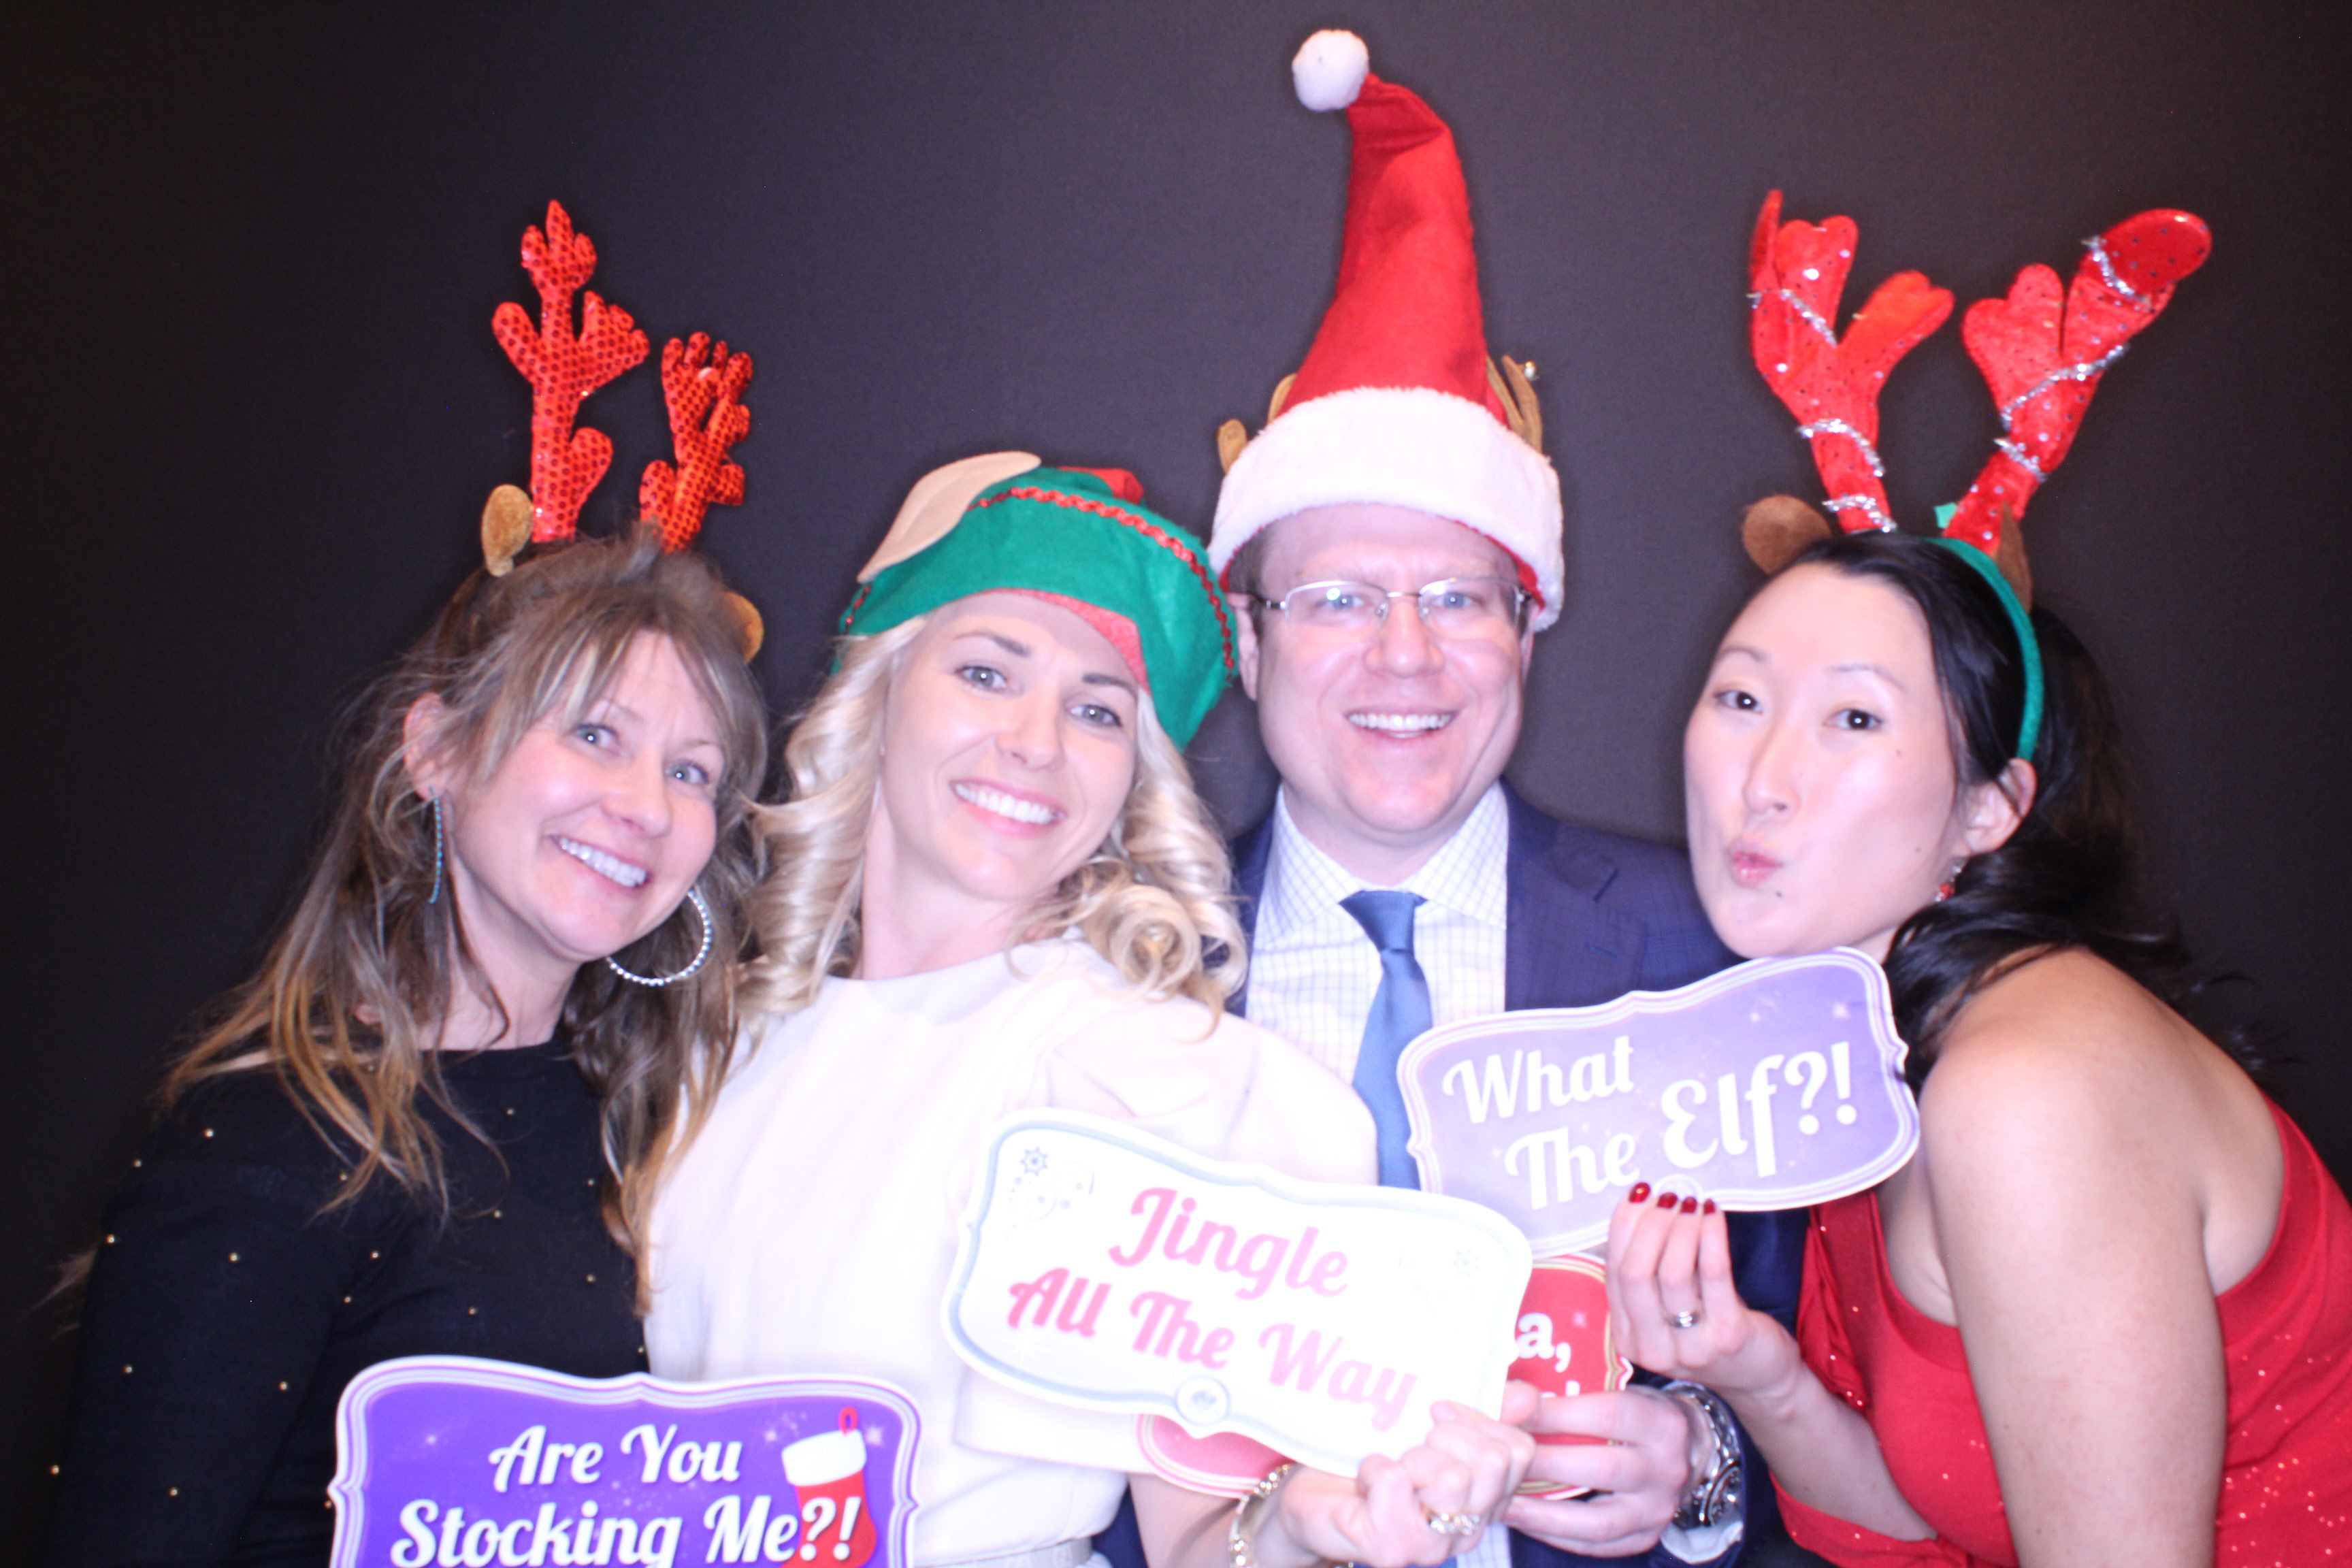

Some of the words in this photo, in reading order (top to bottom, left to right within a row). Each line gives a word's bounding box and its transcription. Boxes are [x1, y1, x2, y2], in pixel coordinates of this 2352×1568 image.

[1442, 1035, 1635, 1124] What
[1505, 1126, 1640, 1210] The
[1661, 1041, 1857, 1177] Elf?!
[1109, 1187, 1350, 1301] Jingle
[1007, 1267, 1111, 1338] All
[1130, 1290, 1236, 1370] The
[1258, 1322, 1418, 1432] Way
[488, 1424, 604, 1492] Are
[620, 1423, 742, 1484] You
[390, 1499, 683, 1568] Stocking
[703, 1494, 862, 1564] Me?!
